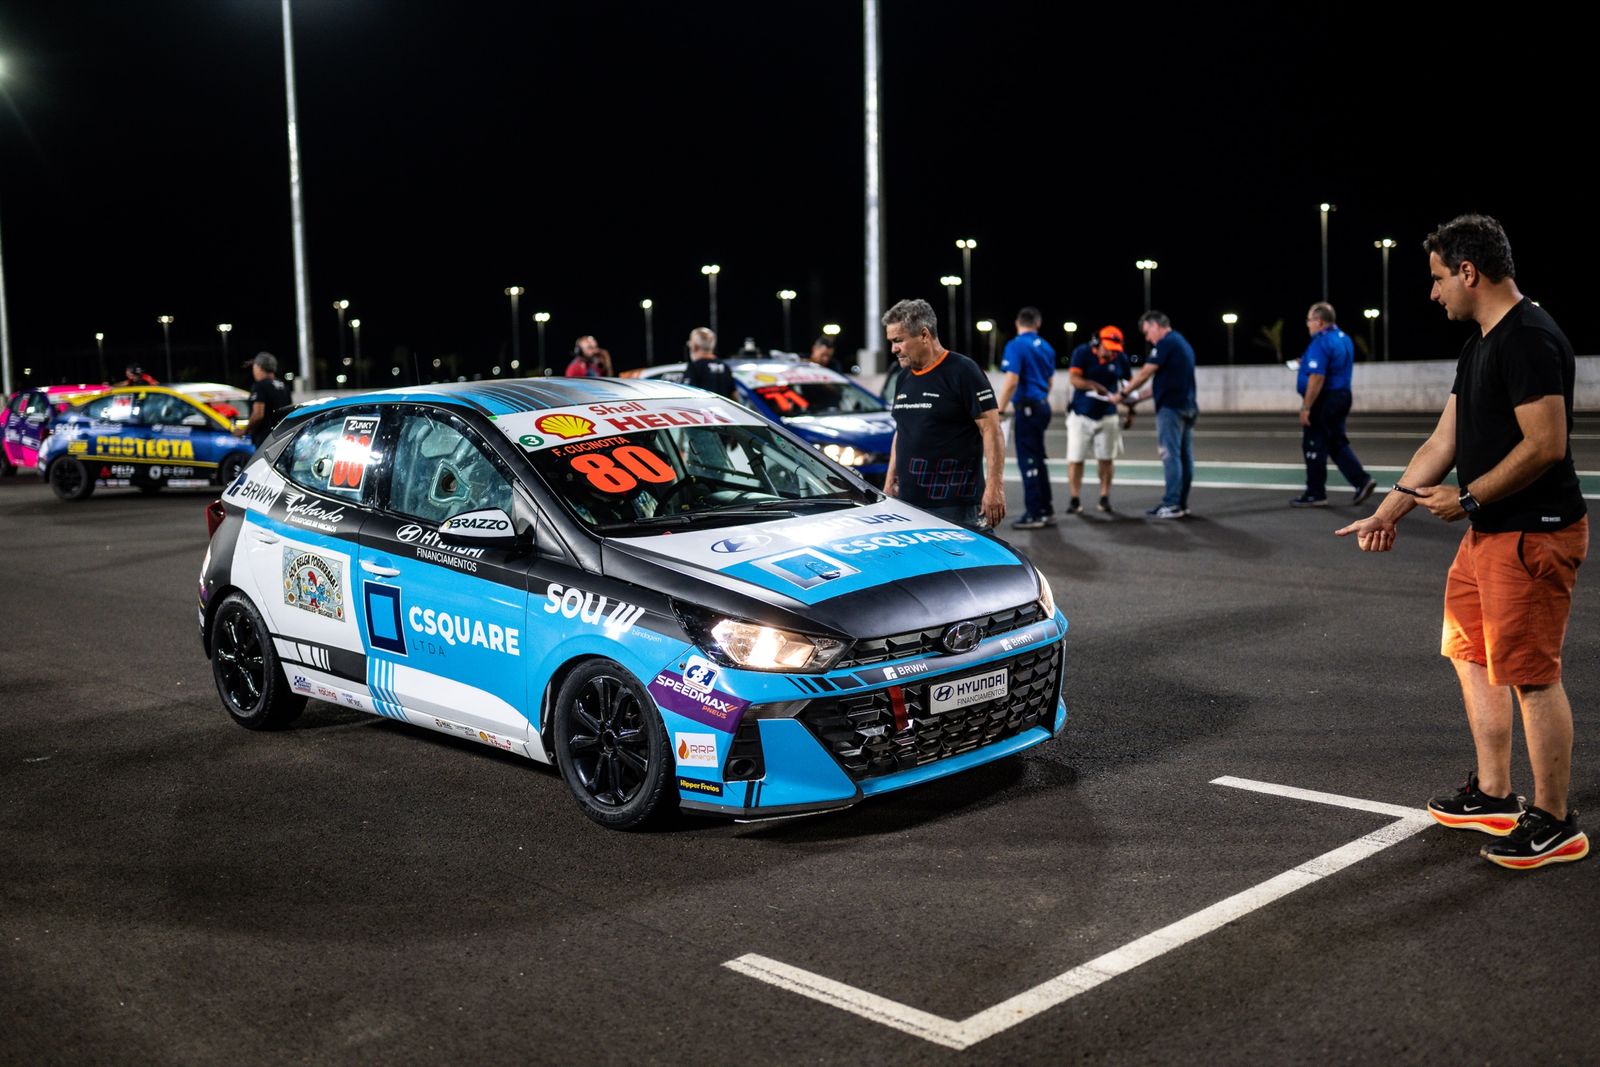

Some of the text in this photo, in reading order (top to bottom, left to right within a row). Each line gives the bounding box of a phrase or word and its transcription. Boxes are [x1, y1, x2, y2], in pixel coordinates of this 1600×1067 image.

[588, 402, 646, 416] Shell
[604, 411, 735, 431] HELIX
[96, 435, 194, 459] PROTECTA
[524, 436, 541, 446] 3
[551, 436, 631, 457] F. CUCINOTTA
[570, 445, 677, 493] 80
[241, 481, 280, 507] BRWM
[285, 493, 345, 522] Gabardo
[449, 518, 509, 531] BRAZZO
[832, 530, 976, 555] CSQUARE
[416, 547, 477, 573] FINANCIAMENTOS
[408, 605, 520, 656] CSQUARE
[1011, 634, 1034, 646] BRWM
[411, 639, 446, 657] LTDA
[897, 663, 929, 676] BRWM
[655, 674, 729, 714] SPEEDMAX
[957, 673, 1005, 696] HYUNDAI
[957, 687, 1005, 706] FINANCIAMENTOS
[702, 705, 728, 719] PNEUS
[690, 744, 715, 754] RRP
